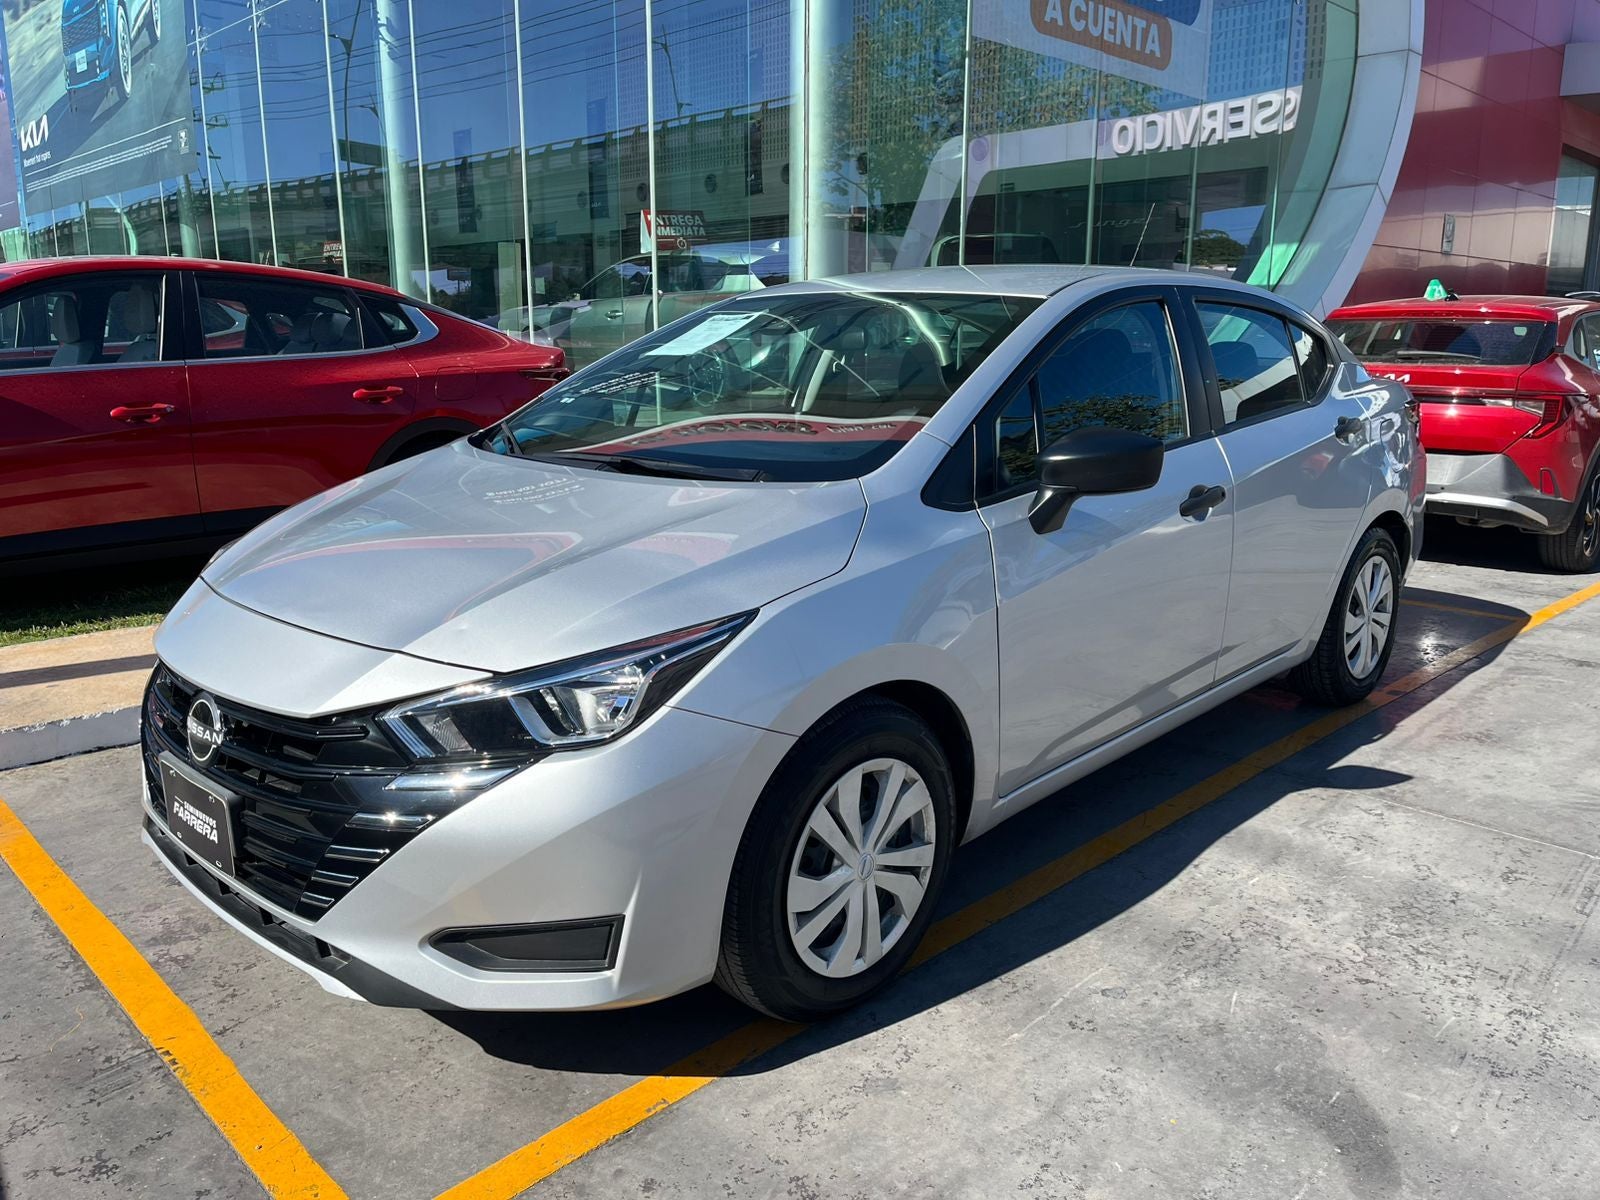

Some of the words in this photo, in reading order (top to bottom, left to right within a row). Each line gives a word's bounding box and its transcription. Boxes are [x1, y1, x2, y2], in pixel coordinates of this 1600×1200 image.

[1044, 0, 1064, 26] A
[1069, 0, 1161, 58] CUENTA
[20, 114, 49, 152] KIA
[647, 214, 703, 226] NTREGA
[656, 226, 706, 236] NMEDIATA
[187, 718, 223, 745] SSAN
[173, 801, 218, 844] FARRERA
